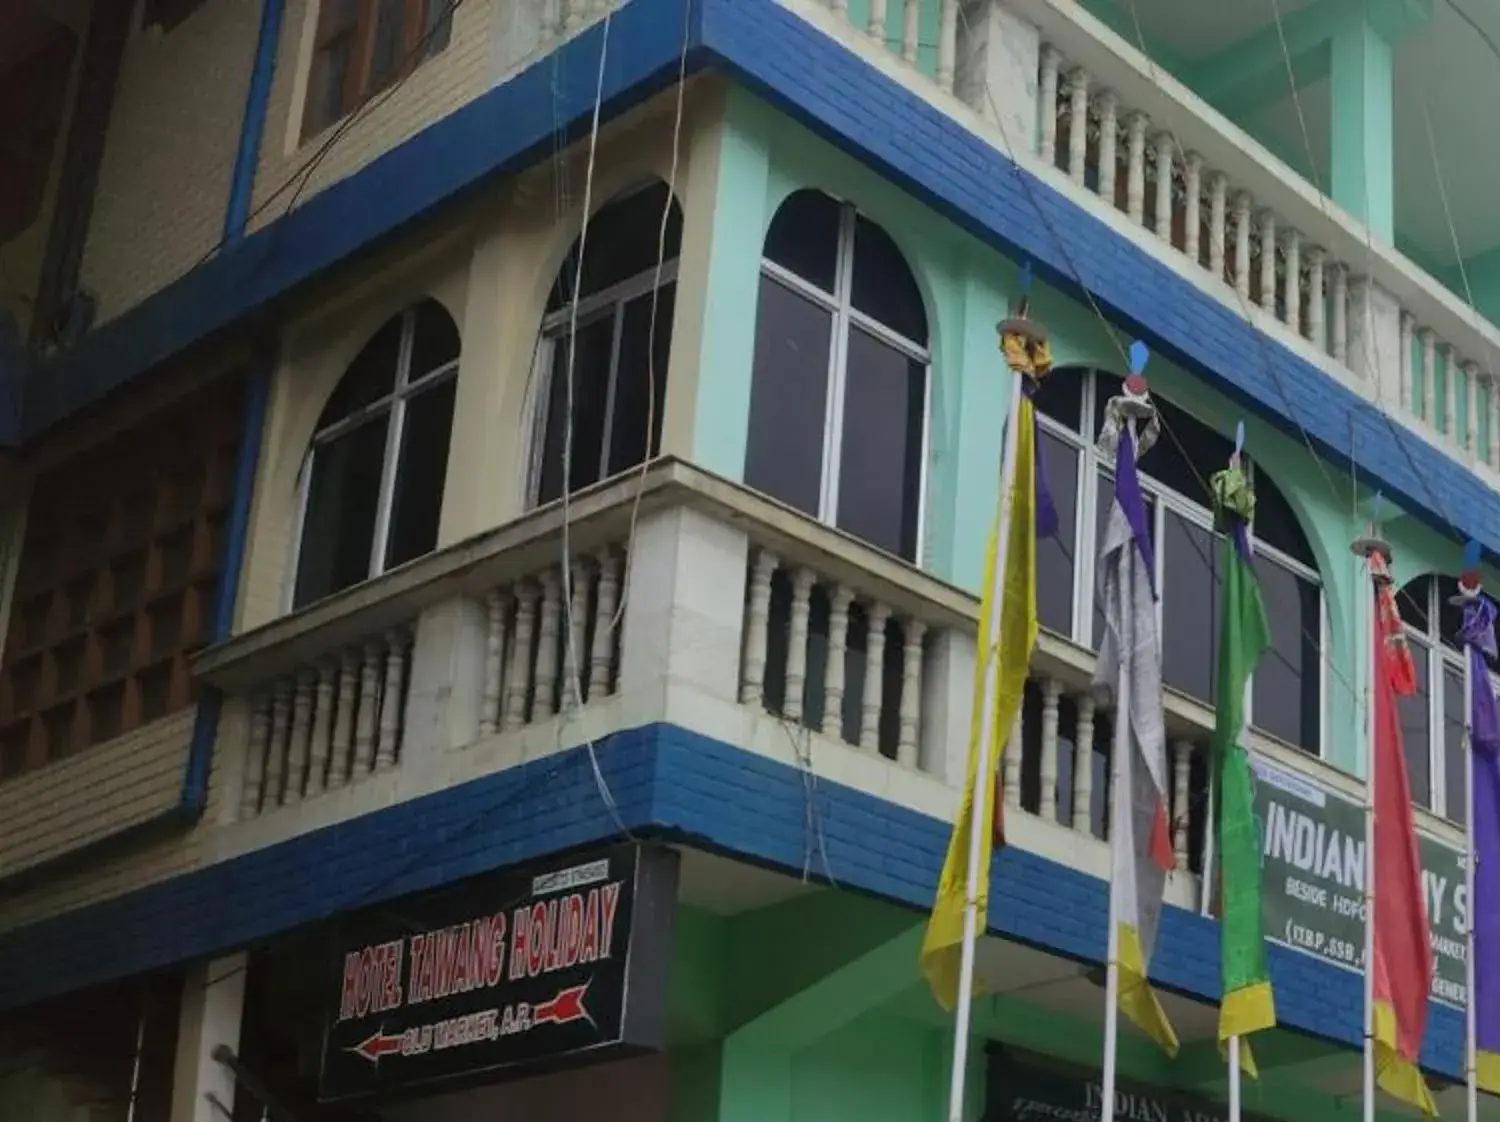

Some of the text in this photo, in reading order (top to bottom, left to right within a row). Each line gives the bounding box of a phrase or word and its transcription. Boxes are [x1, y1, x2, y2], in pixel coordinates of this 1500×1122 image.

[1263, 801, 1365, 891] INDIAN
[1285, 876, 1327, 909] BESIDE
[339, 881, 624, 1022] HOTEL TAWANG HOLIDAY
